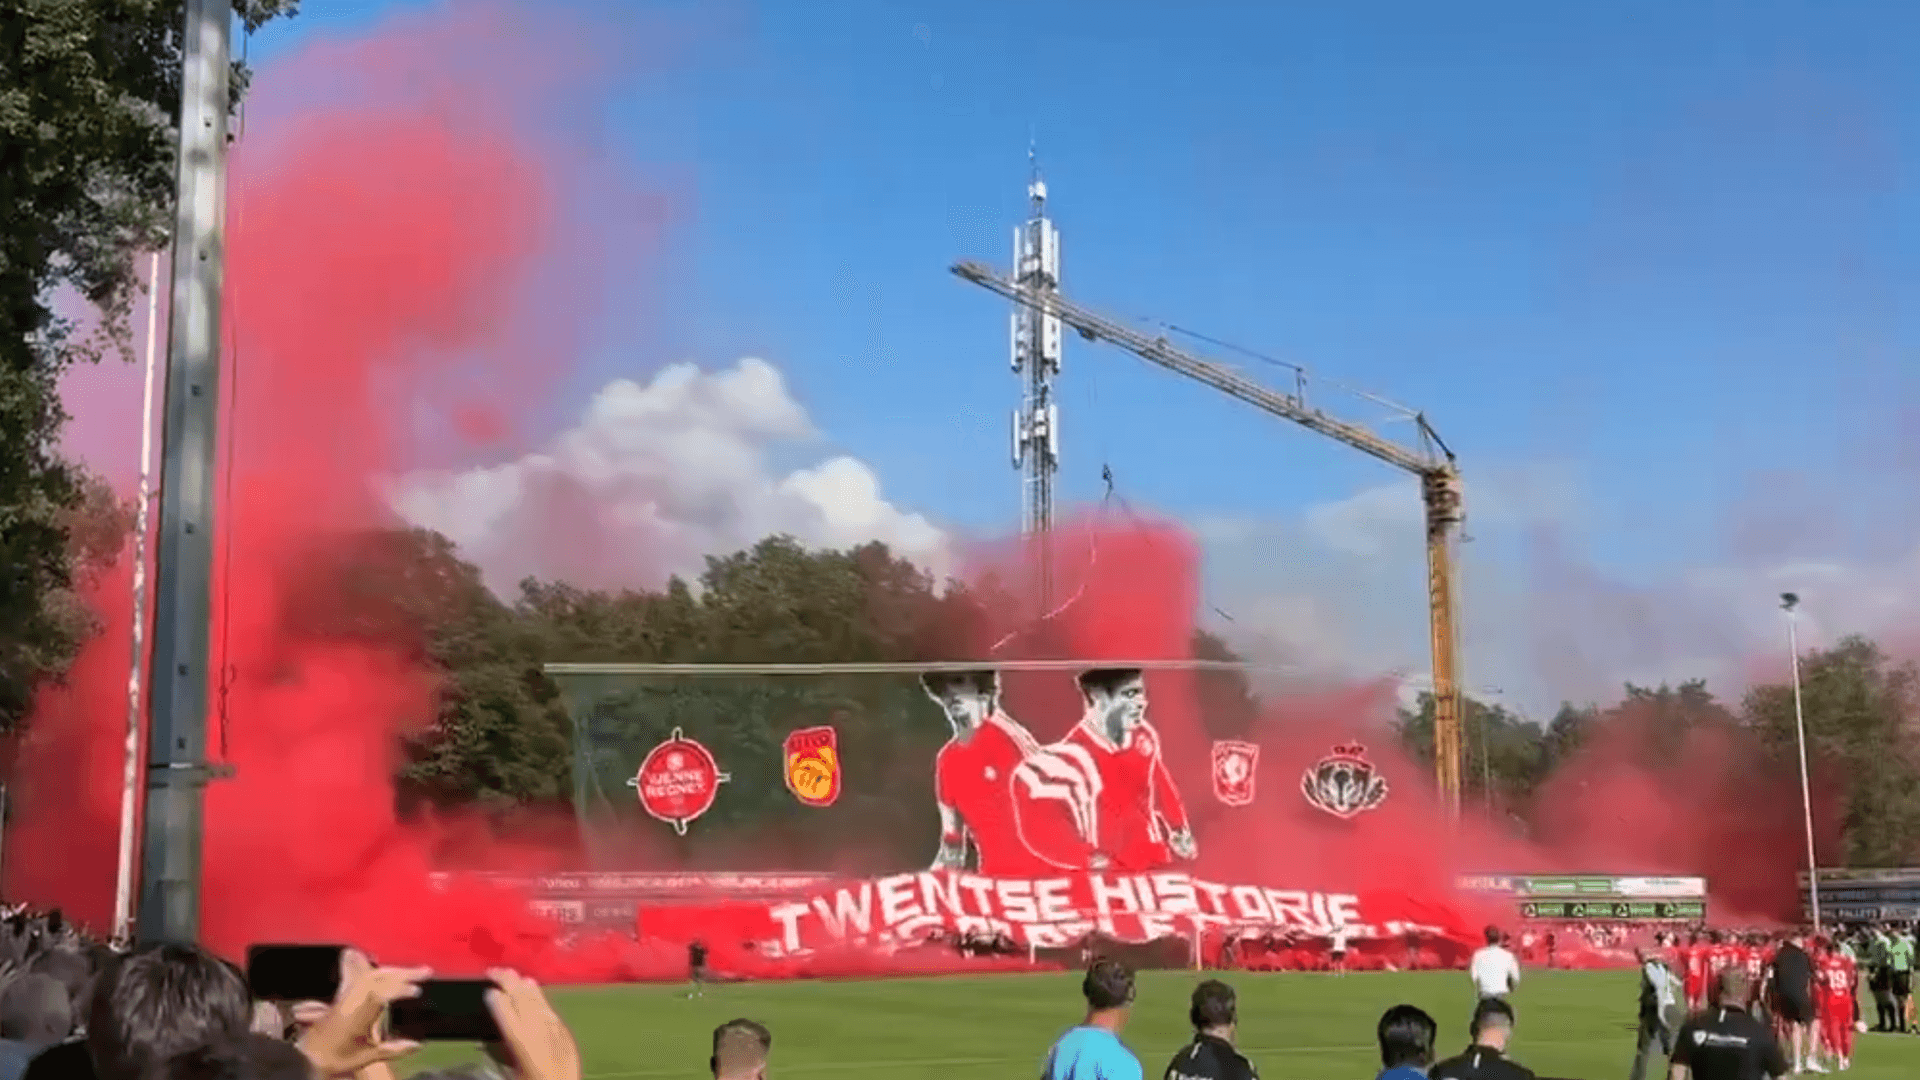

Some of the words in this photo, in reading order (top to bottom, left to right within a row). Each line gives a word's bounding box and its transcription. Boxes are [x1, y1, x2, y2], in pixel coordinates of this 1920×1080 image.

[769, 872, 1078, 952] TWENTSE
[1089, 873, 1360, 929] HISTORIE
[1827, 969, 1848, 990] 19
